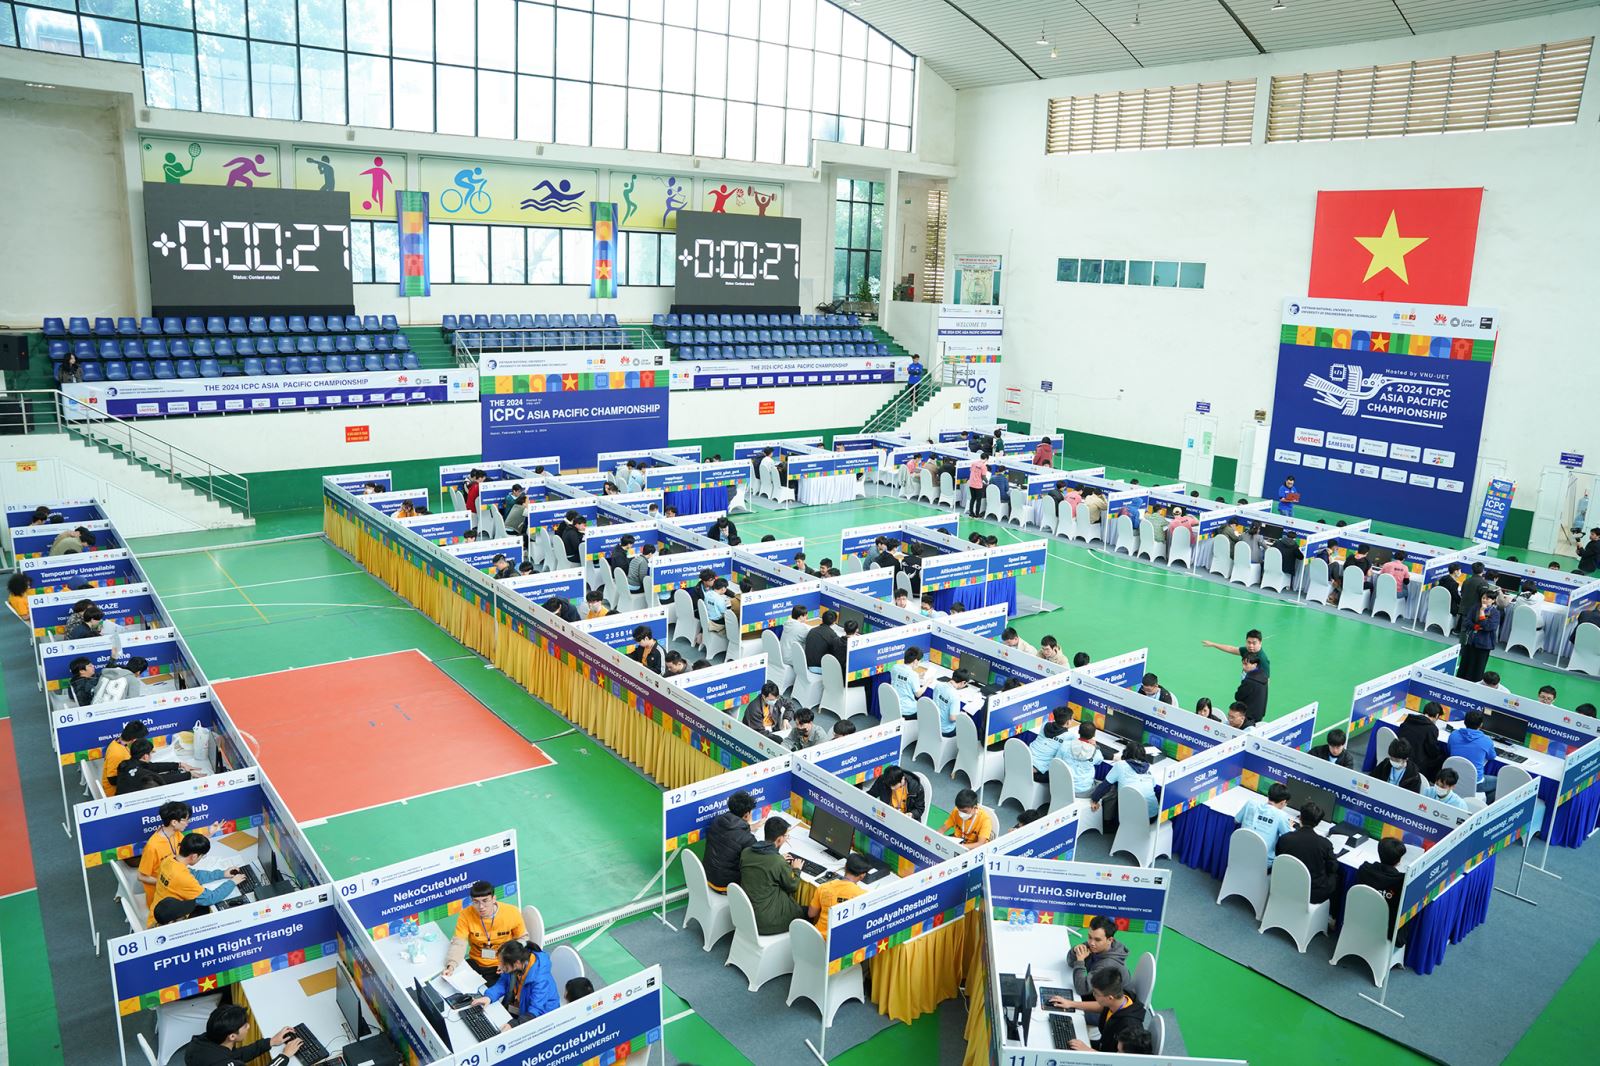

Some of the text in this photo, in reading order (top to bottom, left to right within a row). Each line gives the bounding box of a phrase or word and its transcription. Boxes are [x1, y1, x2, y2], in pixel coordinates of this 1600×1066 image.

[152, 219, 350, 272] +0:00:27
[678, 239, 799, 280] +0:00:27
[1385, 368, 1408, 376] Hosted
[1420, 372, 1450, 380] VNU-UET
[313, 379, 368, 387] CHAMPIONSHIP
[1396, 384, 1451, 398] 2024 ICPC
[1379, 392, 1449, 409] ASIA PACIFIC
[490, 404, 660, 421] ICPC ASIA PACIFIC CHAMPIONSHIP
[1367, 403, 1447, 421] CHAMPIONSHIP
[1485, 500, 1505, 510] ICPC
[40, 565, 115, 578] Temporarily Unavailable
[661, 567, 674, 576] FPTU
[683, 565, 697, 573] Ching
[46, 646, 58, 655] 05
[851, 640, 860, 648] 37
[991, 662, 1011, 674] PACIFIC
[707, 683, 728, 693] Bossin
[59, 715, 74, 724] 06
[1088, 698, 1169, 733] THE PACIFIC
[1428, 690, 1580, 742] THE 2024 ICPC HAMPIONSHIP
[676, 709, 735, 748] THE 2024 ICPC ASIA PACIFIC
[841, 755, 858, 766] sudo
[862, 754, 887, 766] TECHNOLOGY
[669, 793, 682, 805] 12
[1267, 765, 1438, 835] THE PACIFIC CHAMPIONSHIP
[83, 806, 99, 818] 07
[808, 789, 889, 841] THE 2024 ICPC ASIA PACIFIC
[974, 852, 984, 864] 13
[989, 861, 1001, 871] 11
[341, 884, 357, 896] 09
[393, 872, 468, 903] NekoCuteUwU
[1018, 884, 1126, 902] UIT.HHQ.SilverBullet
[381, 892, 444, 917] NATIONAL CENTRAL
[866, 893, 938, 930] DoaAyahRestuIbu
[836, 909, 849, 920] 12
[863, 903, 938, 940] INSTITUT TEKNOLOGI BANDUNG
[118, 941, 139, 956] 08
[153, 952, 191, 971] FPTU
[194, 945, 214, 960] HN
[217, 936, 252, 954] Right
[254, 922, 304, 943] Triangle
[202, 946, 263, 968] FPT UNIVERSITY
[521, 1022, 606, 1066] NekoCuteUwU
[546, 1049, 580, 1066] CENTRAL
[580, 1030, 621, 1054] UNIVERSITY
